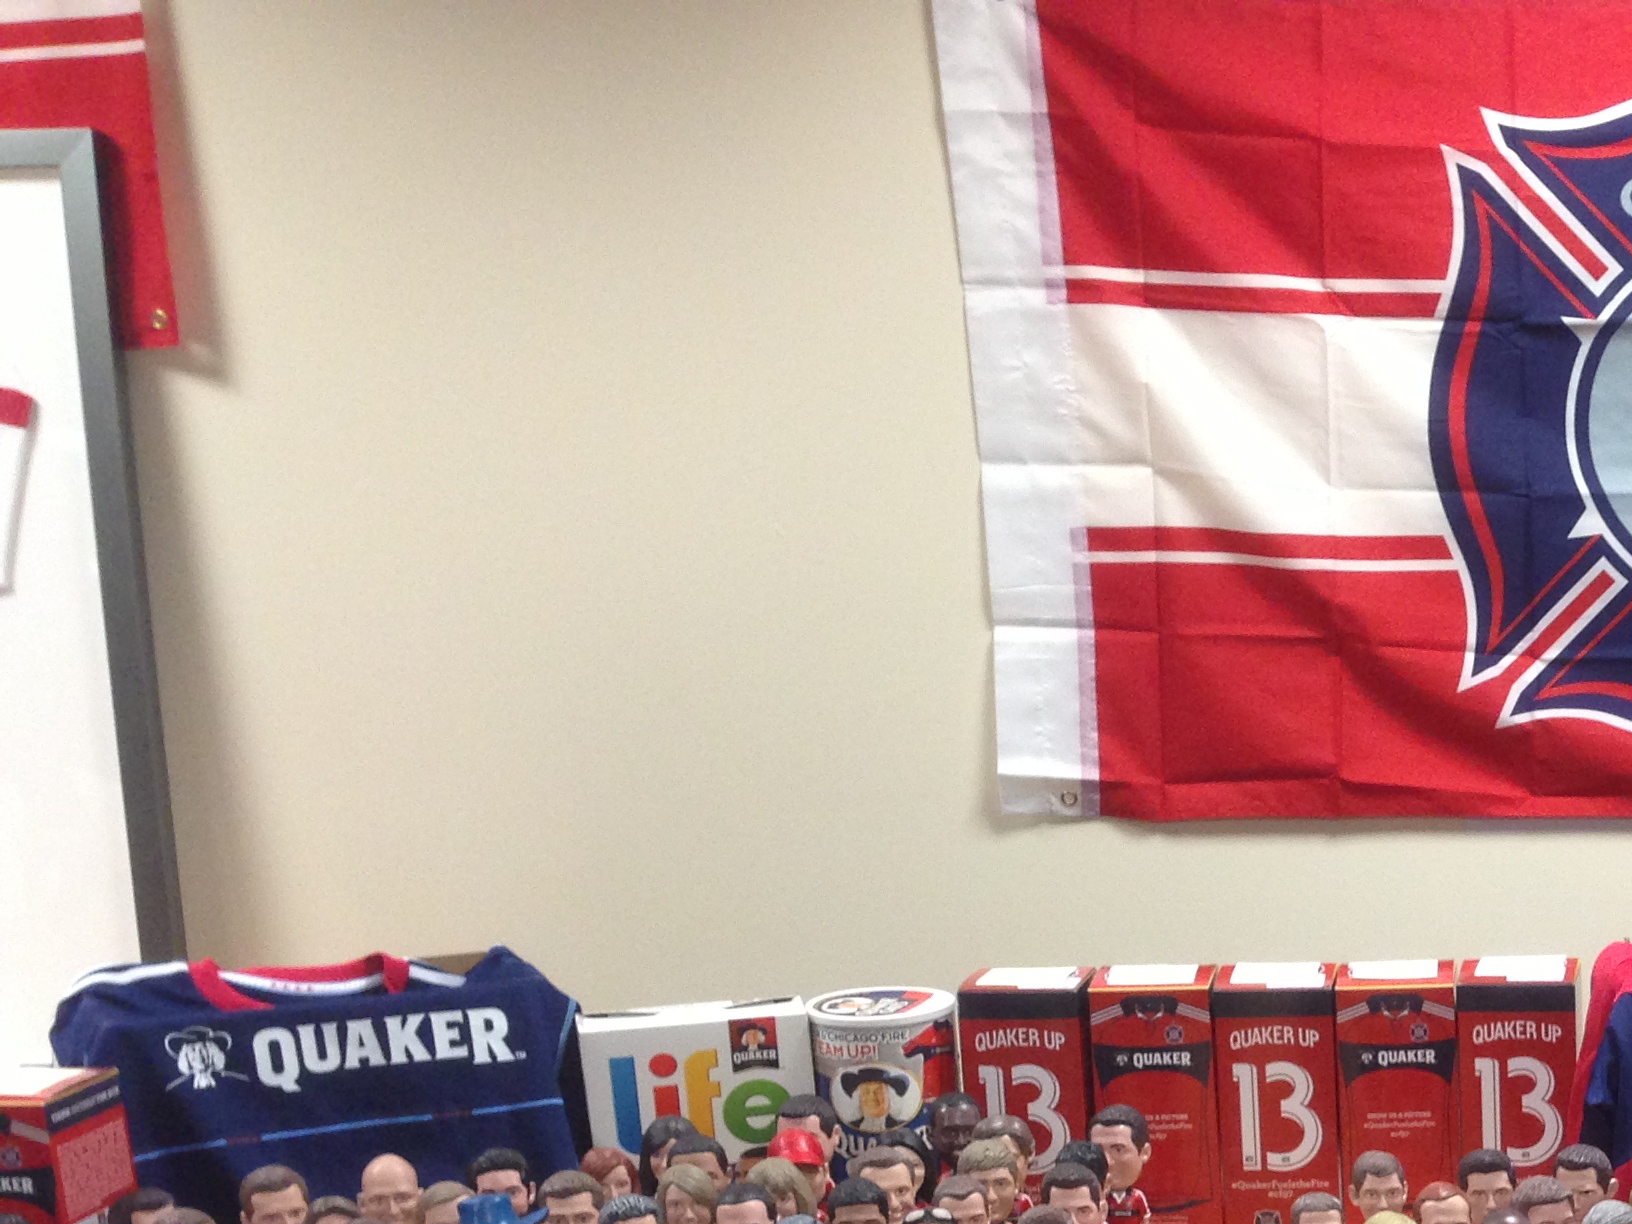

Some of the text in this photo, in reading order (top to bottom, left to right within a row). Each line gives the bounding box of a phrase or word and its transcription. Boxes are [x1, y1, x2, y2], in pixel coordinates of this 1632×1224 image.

[975, 1028, 1065, 1051] QUAKER UP
[1230, 1026, 1320, 1050] QUAKER UP
[1473, 1020, 1562, 1044] QUAKER UP
[252, 1007, 514, 1093] QUAKER
[733, 1048, 777, 1064] QUAKER
[1133, 1052, 1191, 1069] QUAKER
[1377, 1050, 1435, 1066] QUAKER
[609, 1049, 791, 1155] life
[1474, 1056, 1564, 1167] 13
[1232, 1061, 1324, 1172] 13
[0, 1176, 34, 1195] KER
